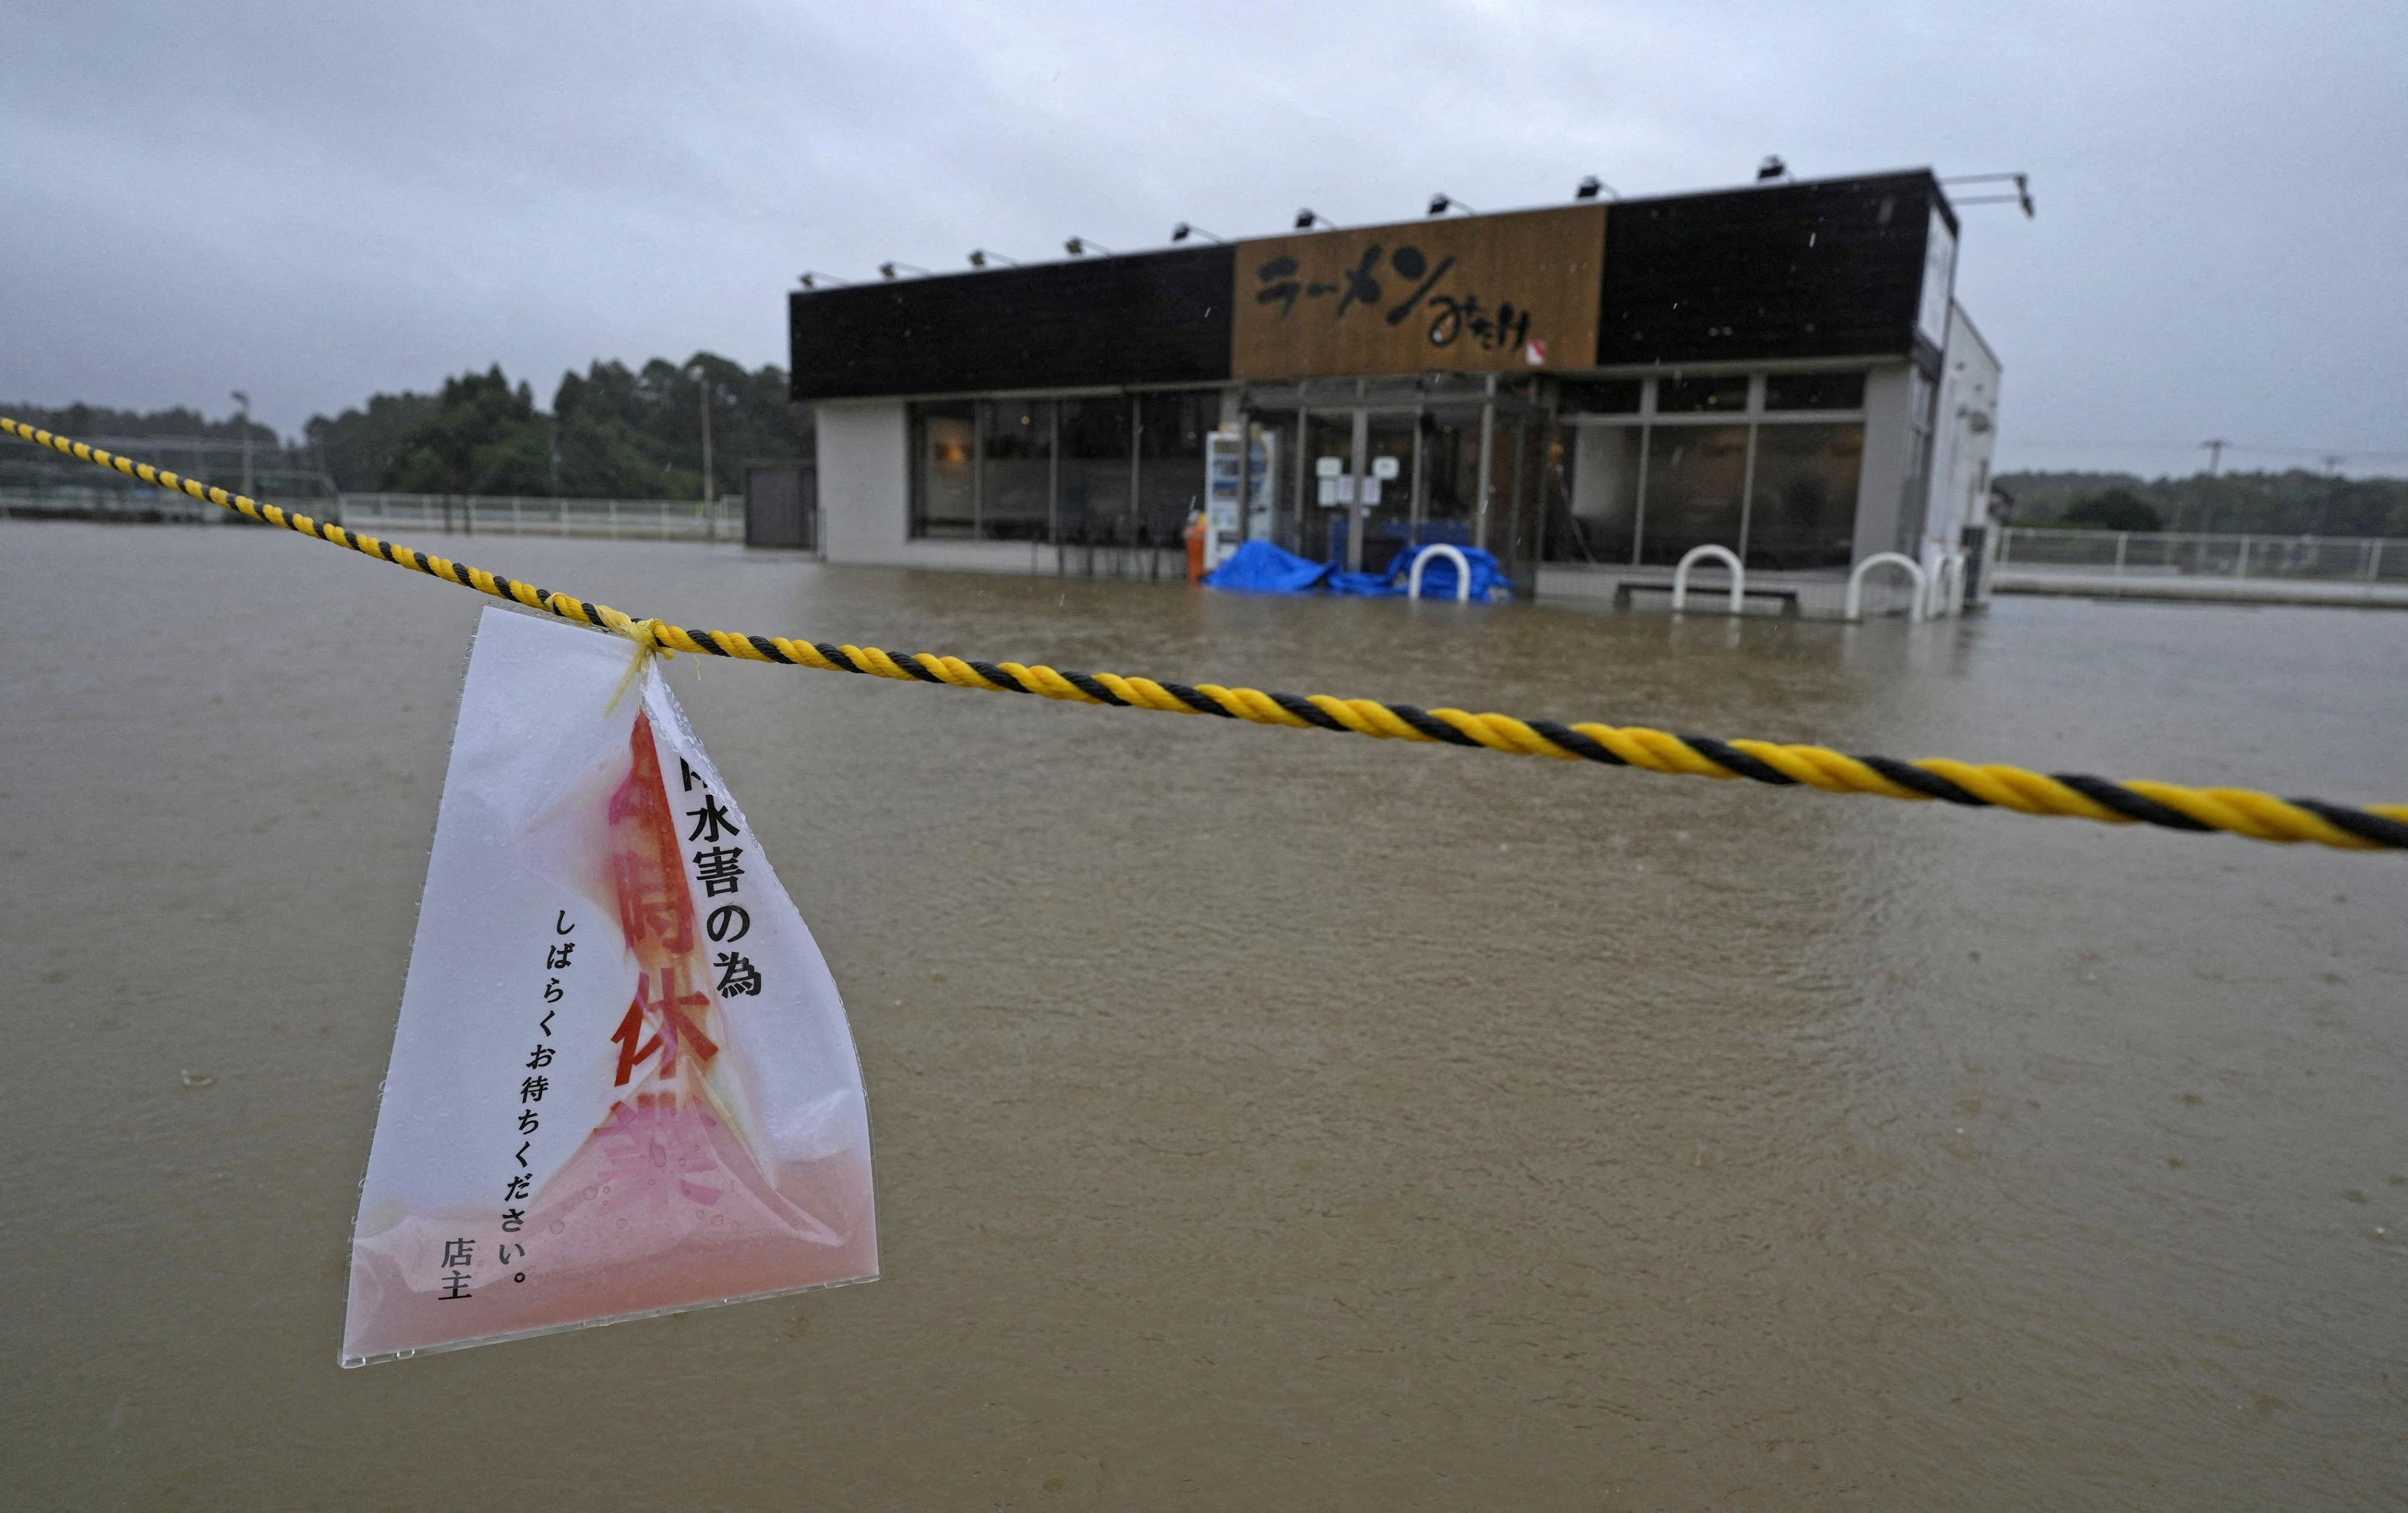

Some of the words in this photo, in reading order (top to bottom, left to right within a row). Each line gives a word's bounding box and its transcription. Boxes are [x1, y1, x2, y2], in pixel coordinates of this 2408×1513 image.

[1256, 243, 1455, 325] ラーメン
[498, 910, 575, 1285] しばらくお待ちください。
[438, 1238, 476, 1302] 店主
